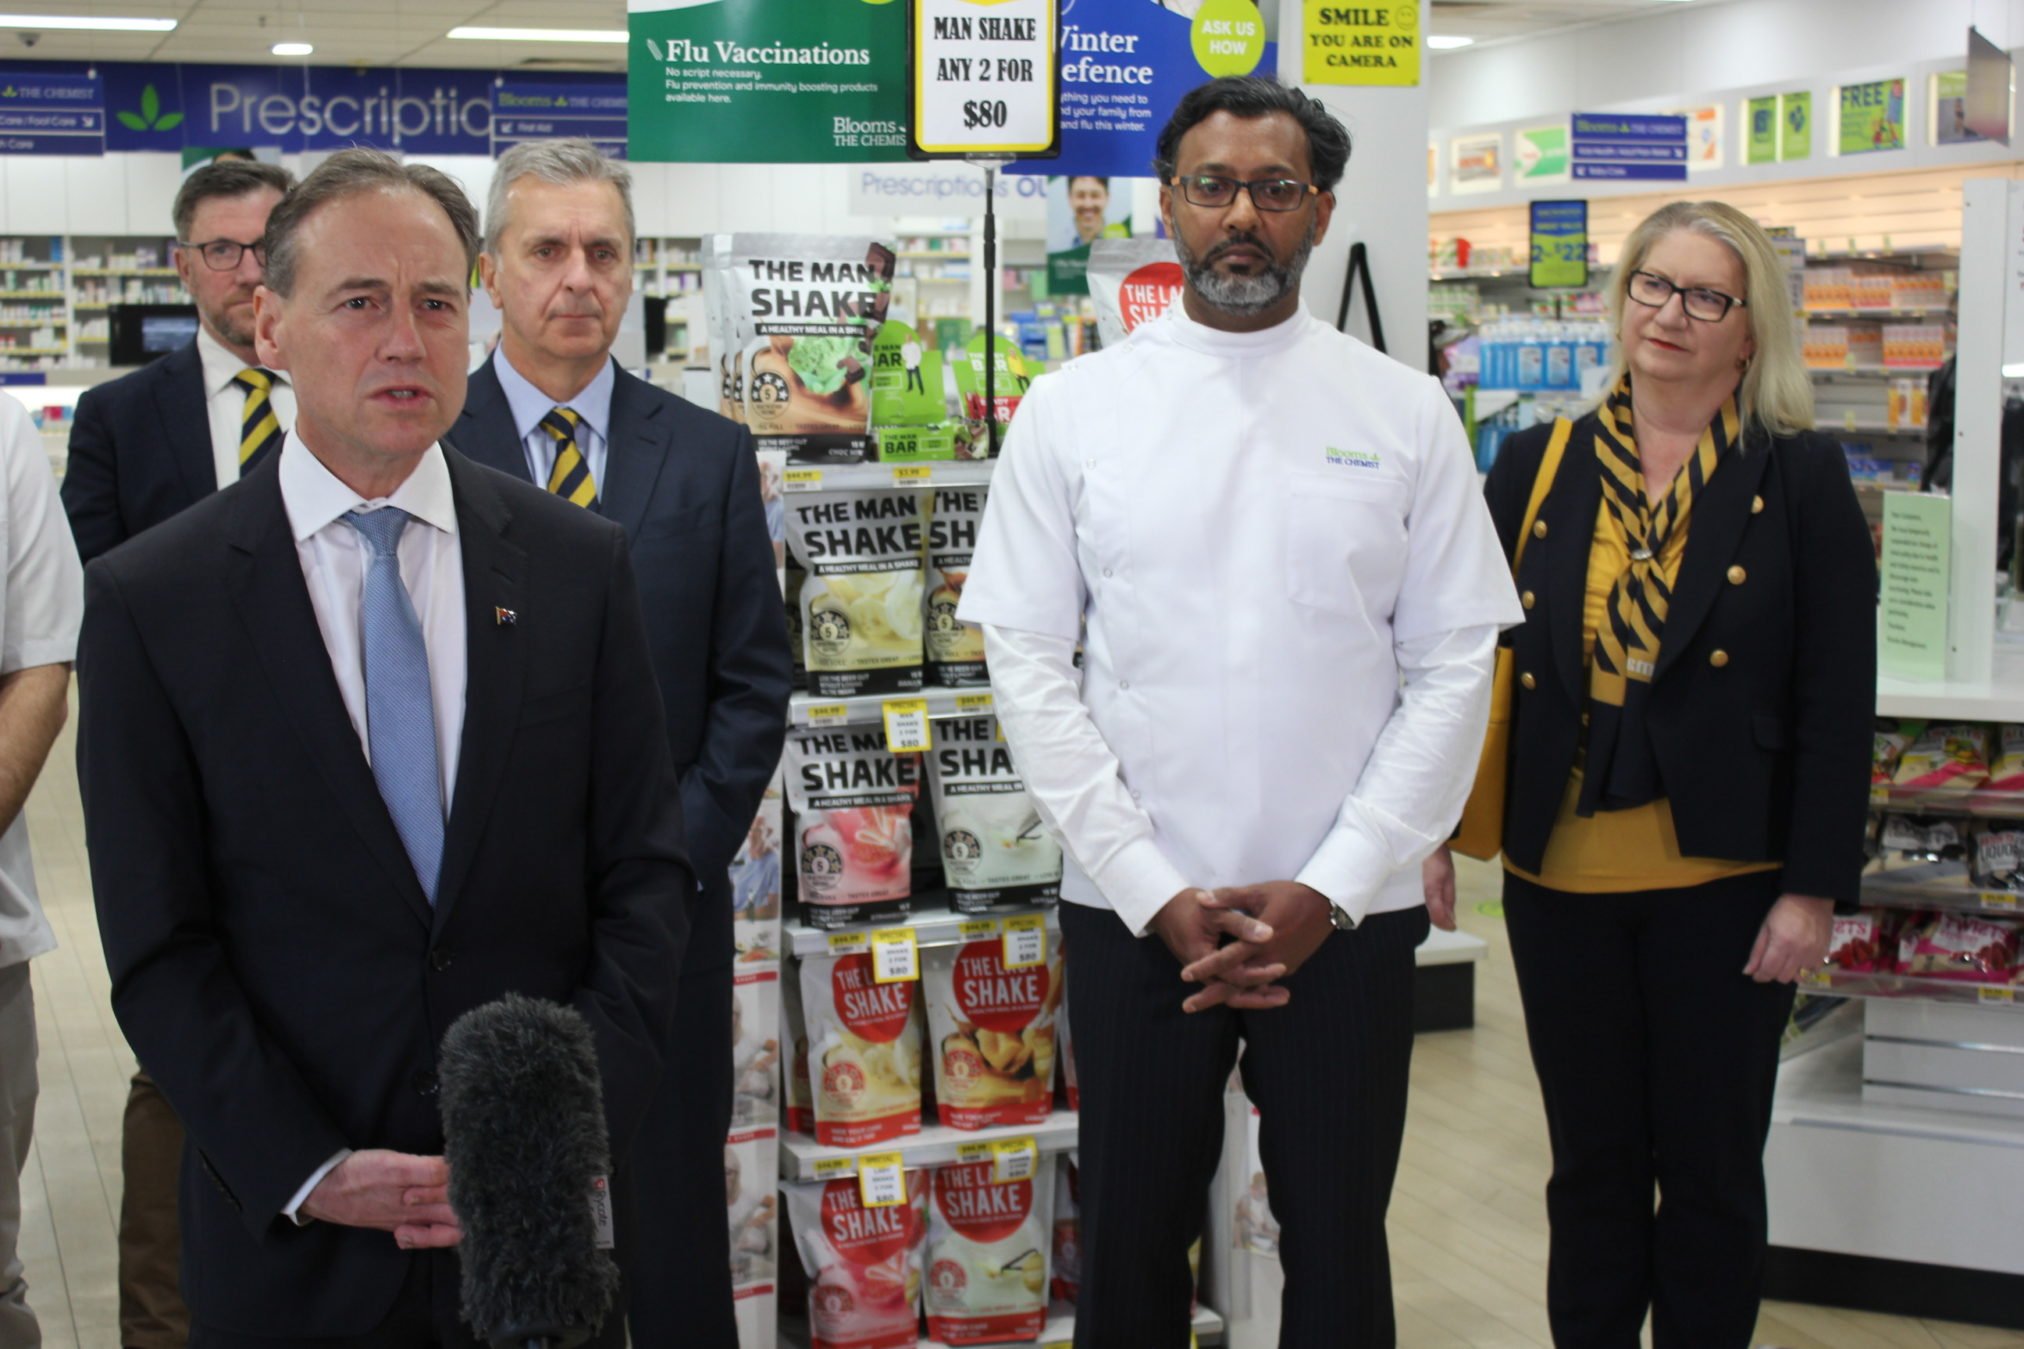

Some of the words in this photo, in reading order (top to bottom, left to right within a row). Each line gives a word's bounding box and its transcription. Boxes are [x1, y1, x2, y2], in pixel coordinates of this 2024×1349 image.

[1319, 8, 1390, 26] SMILE
[934, 17, 972, 40] MAN
[979, 17, 1036, 41] SHAKE
[1202, 20, 1231, 35] ASK
[1236, 21, 1256, 36] US
[1210, 40, 1247, 55] HOW
[1310, 34, 1345, 47] YOU
[1351, 35, 1384, 48] ARE
[1389, 36, 1413, 48] ON
[666, 39, 710, 62] Flu
[714, 41, 870, 65] Vaccinations
[1326, 54, 1397, 67] CAMERA
[666, 67, 681, 77] No
[683, 68, 710, 79] script
[712, 70, 762, 80] necessary.
[936, 58, 973, 81] ANY
[979, 58, 991, 81] 2
[997, 59, 1033, 82] FOR
[1062, 56, 1153, 84] efence
[19, 87, 41, 98] THE
[43, 87, 94, 99] CHEMIST
[666, 80, 680, 90] Flu
[682, 81, 733, 92] prevention
[735, 82, 753, 91] and
[755, 82, 797, 93] immunity
[798, 82, 838, 94] boosting
[840, 83, 878, 93] products
[1840, 81, 1884, 108] FREE
[666, 93, 706, 103] available
[708, 94, 732, 103] here.
[1091, 95, 1109, 105] you
[1111, 94, 1135, 104] need
[1137, 95, 1148, 104] to
[50, 117, 76, 126] Care
[963, 100, 1007, 129] $80
[1073, 108, 1095, 118] your
[1098, 107, 1127, 119] family
[1129, 108, 1152, 118] from
[833, 117, 896, 133] Blooms
[1080, 120, 1093, 130] flu
[1095, 120, 1112, 130] this
[1115, 121, 1145, 131] winter.
[833, 135, 858, 146] THE
[860, 135, 906, 146] CHEMIS
[862, 172, 1008, 199] Prescriptios
[749, 259, 804, 282] THE
[811, 262, 876, 284] MAN
[751, 288, 878, 318] SHAKE
[1124, 285, 1156, 304] THE
[761, 325, 768, 333] A
[768, 325, 804, 333] HEALTHY
[805, 325, 828, 334] MEAL
[828, 326, 838, 334] IN
[838, 326, 845, 334] A
[873, 353, 902, 367] AR
[972, 359, 1007, 372] BR
[765, 389, 771, 400] 5
[885, 441, 917, 454] BAR
[1326, 456, 1342, 464] THE
[1344, 458, 1379, 469] CHEMIST
[797, 502, 849, 525] THE
[855, 495, 917, 520] MAN
[932, 491, 979, 513] THE
[804, 523, 923, 558] SHAKE
[819, 565, 825, 573] A
[825, 563, 858, 573] HEALTHY
[858, 562, 878, 572] MEAL
[878, 562, 887, 571] IN
[887, 562, 894, 571] A
[894, 559, 919, 570] SHAKE
[825, 625, 832, 637] 5
[935, 719, 989, 742] THE
[800, 733, 848, 755] THE
[801, 757, 915, 792] SHAKE
[957, 784, 990, 793] HEALTHY
[992, 783, 1012, 792] MEAL
[814, 799, 820, 807] A
[820, 798, 852, 807] HEALTHY
[817, 860, 824, 871] 5
[961, 957, 991, 977] THE
[836, 967, 862, 991] THE
[963, 976, 1040, 1007] SHAKE
[845, 983, 907, 1018] SHAKE
[942, 1165, 972, 1187] THE
[826, 1188, 857, 1212] THE
[945, 1184, 1023, 1217] SHAKE
[833, 1203, 903, 1242] SHAKE
